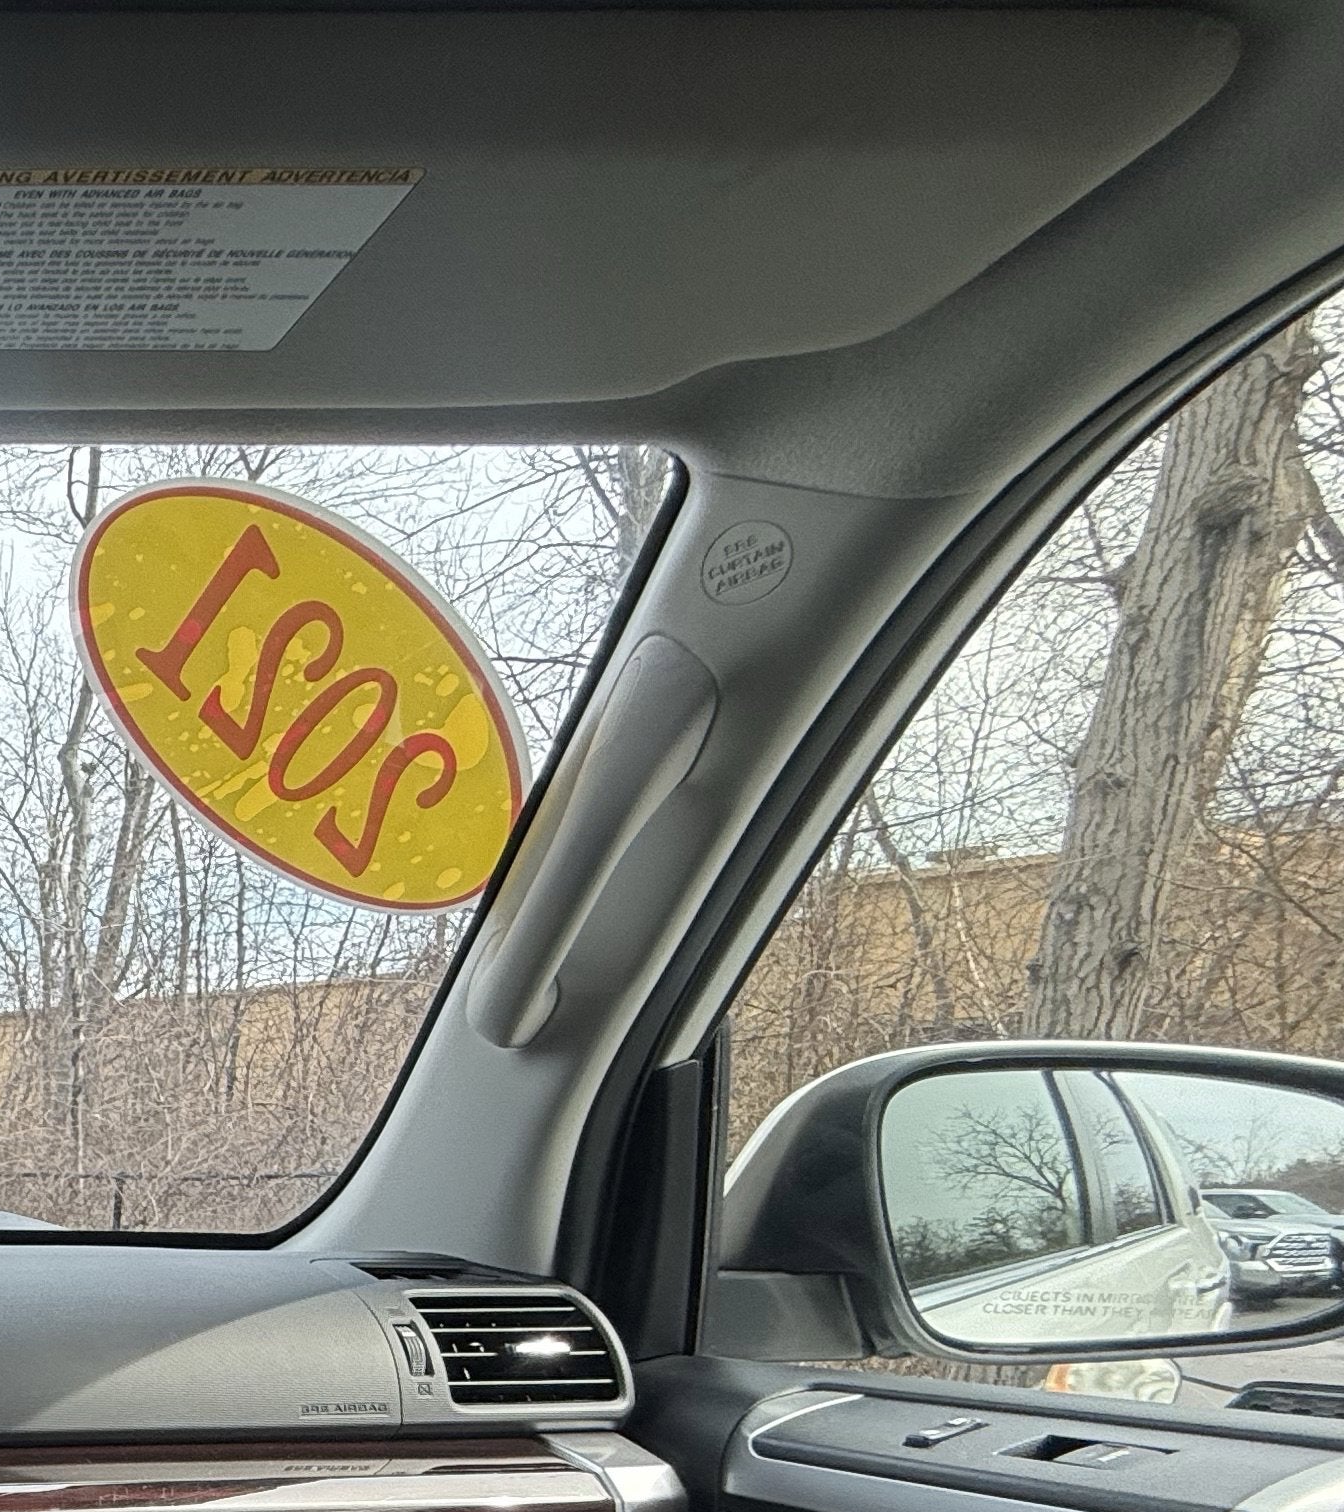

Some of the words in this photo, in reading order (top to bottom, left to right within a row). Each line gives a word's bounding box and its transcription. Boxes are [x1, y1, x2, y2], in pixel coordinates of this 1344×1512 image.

[43, 170, 251, 184] AVERTISSEMENT
[261, 169, 411, 183] ADVERTENCIA
[13, 189, 44, 199] EVEN
[49, 189, 78, 199] WITH
[81, 189, 140, 199] ADVANCED
[144, 189, 165, 199] AIR
[168, 189, 202, 199] BAGS
[708, 540, 785, 580] CURTAIN
[715, 557, 784, 596] AIRBAG
[1076, 1292, 1096, 1303] IN
[982, 1303, 1046, 1315] CLOSER
[1052, 1304, 1096, 1316] THAN
[1101, 1306, 1143, 1318] THEY
[334, 1403, 388, 1413] AIRBAG
